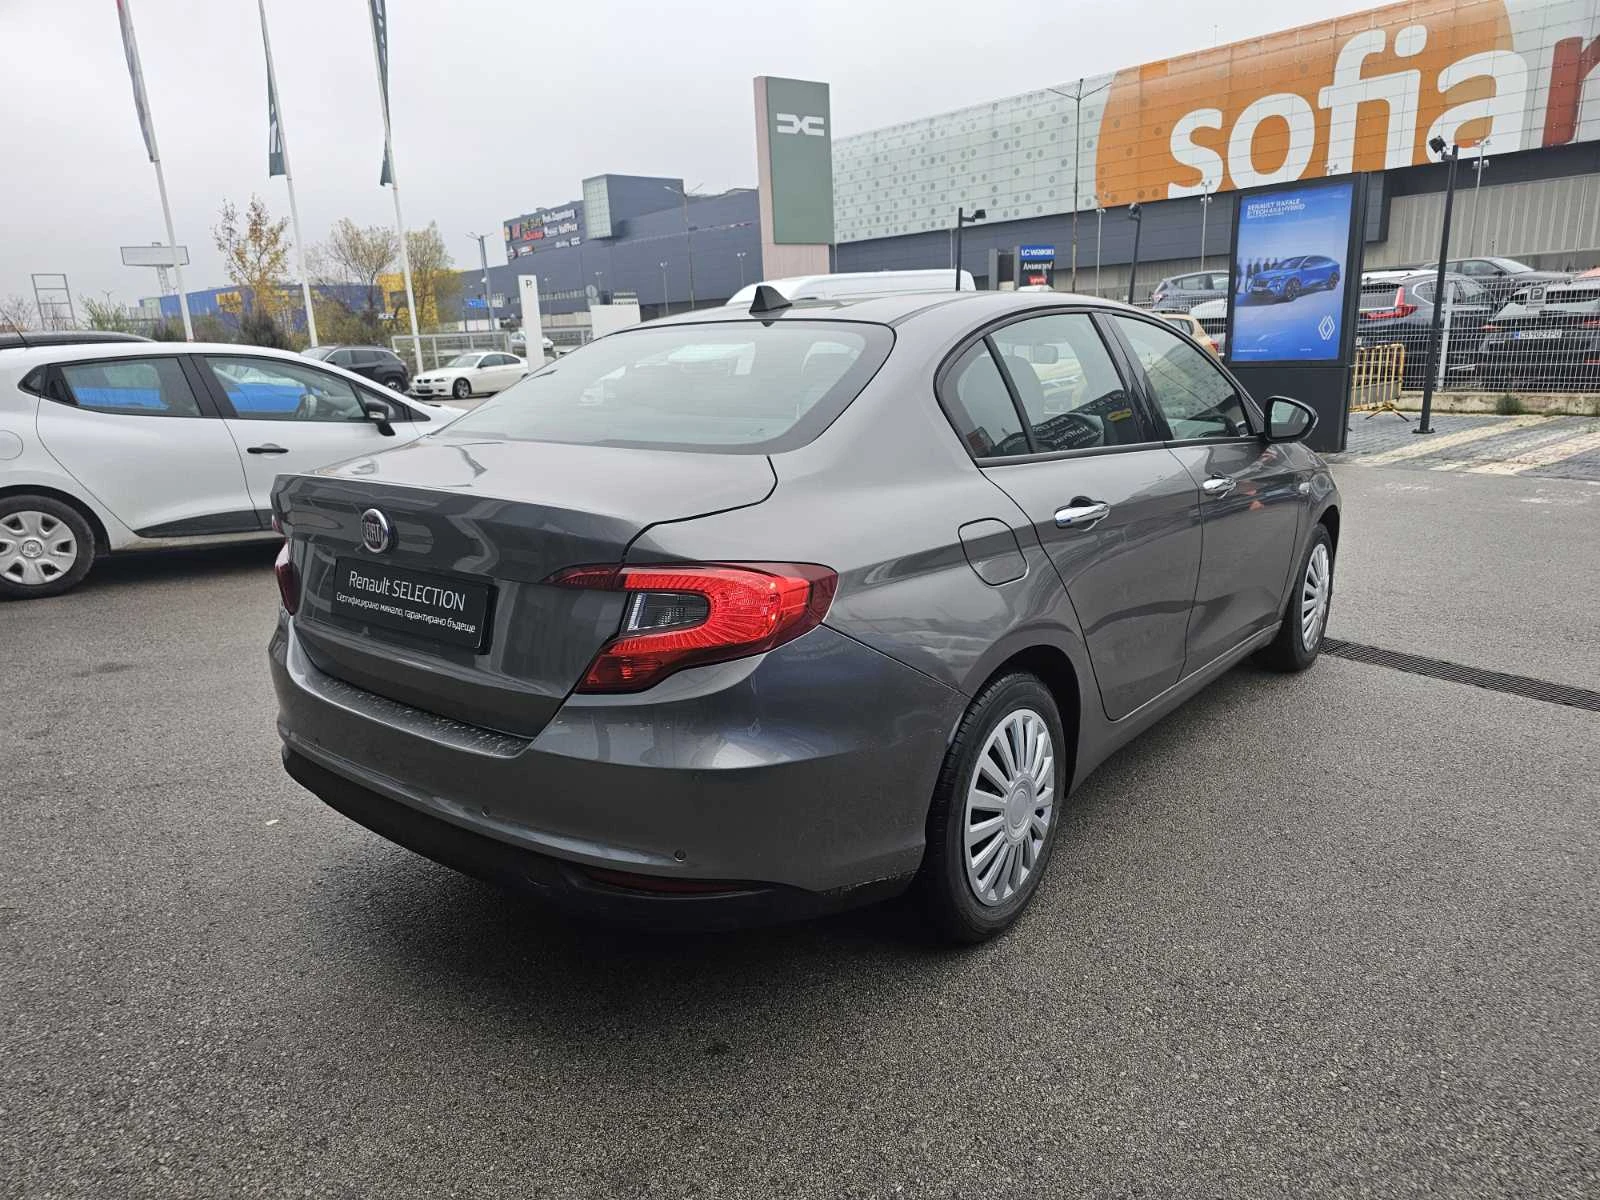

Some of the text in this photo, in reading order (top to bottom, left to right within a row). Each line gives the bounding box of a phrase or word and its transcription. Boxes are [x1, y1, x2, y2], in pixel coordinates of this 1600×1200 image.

[349, 570, 466, 612] Renault SELECTION
[336, 592, 379, 611] Сертифицирано
[404, 609, 447, 627] гарантирано
[447, 618, 476, 633] бъдеще
